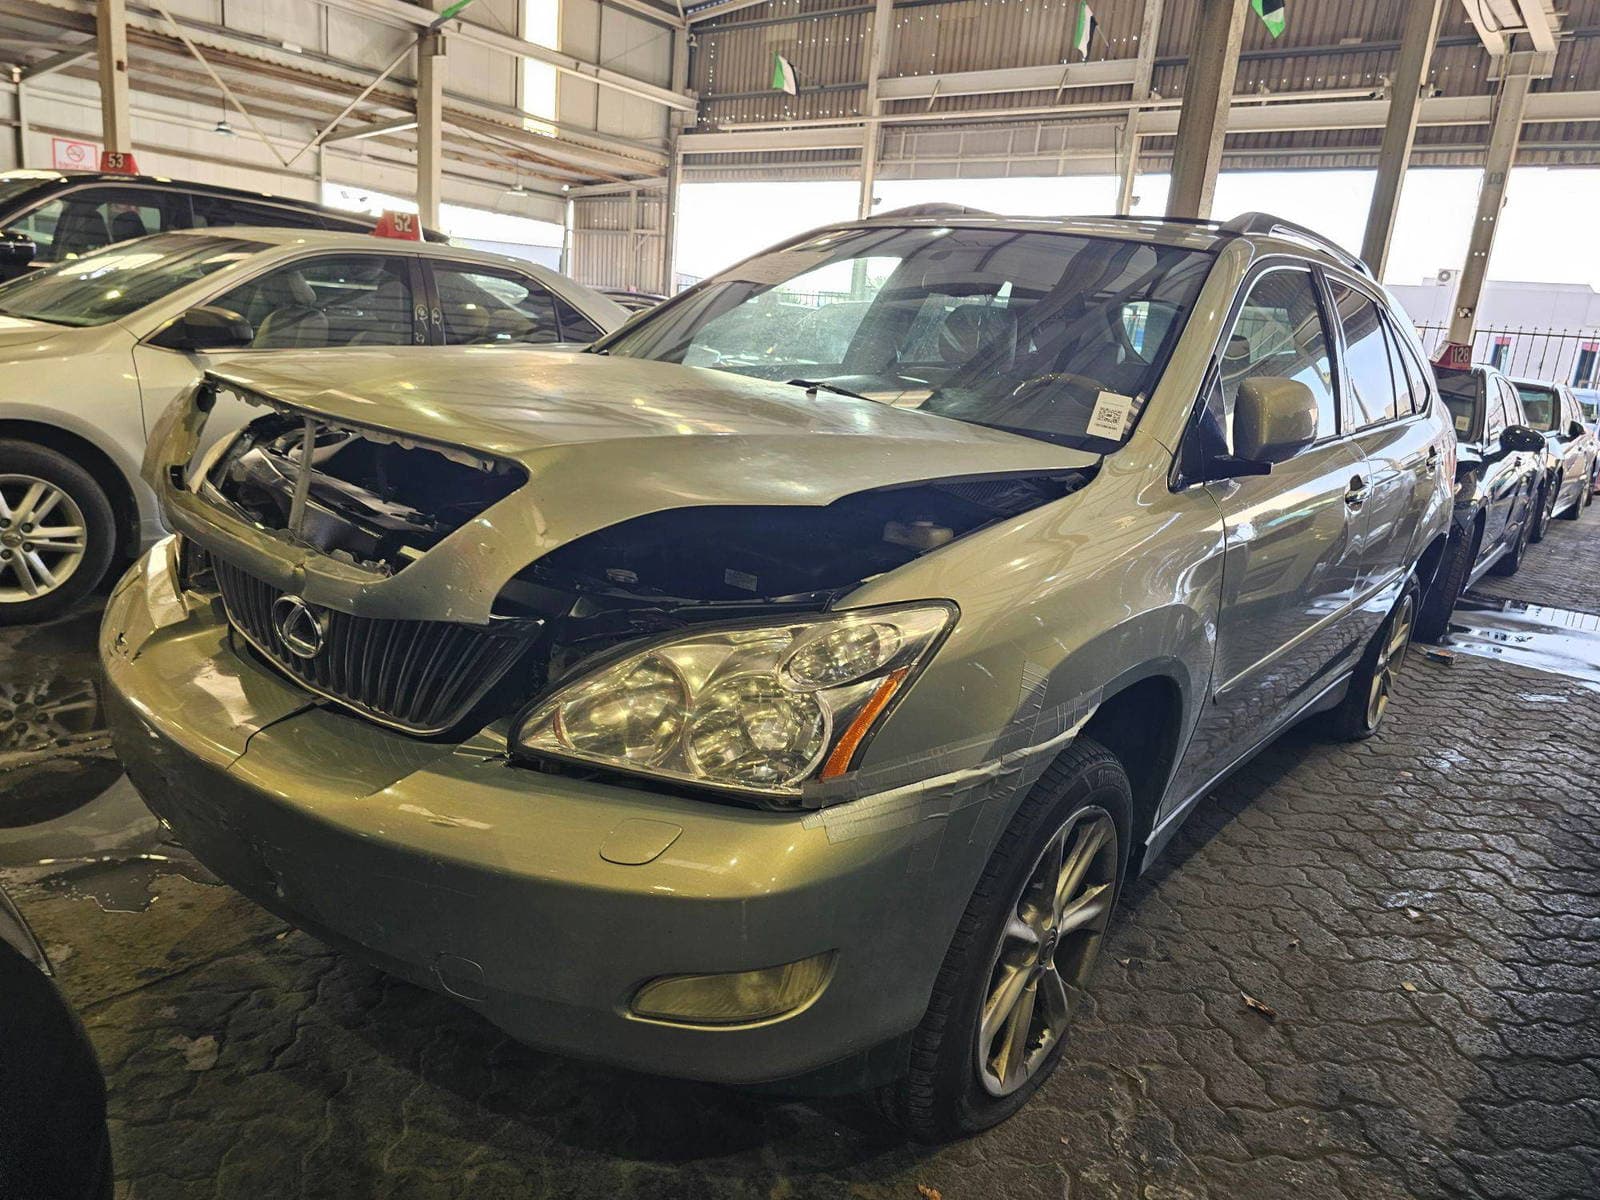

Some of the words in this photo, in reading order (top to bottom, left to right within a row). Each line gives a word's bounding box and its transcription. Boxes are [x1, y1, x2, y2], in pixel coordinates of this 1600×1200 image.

[108, 153, 124, 169] 53
[394, 212, 413, 233] 52
[1454, 346, 1470, 363] 128
